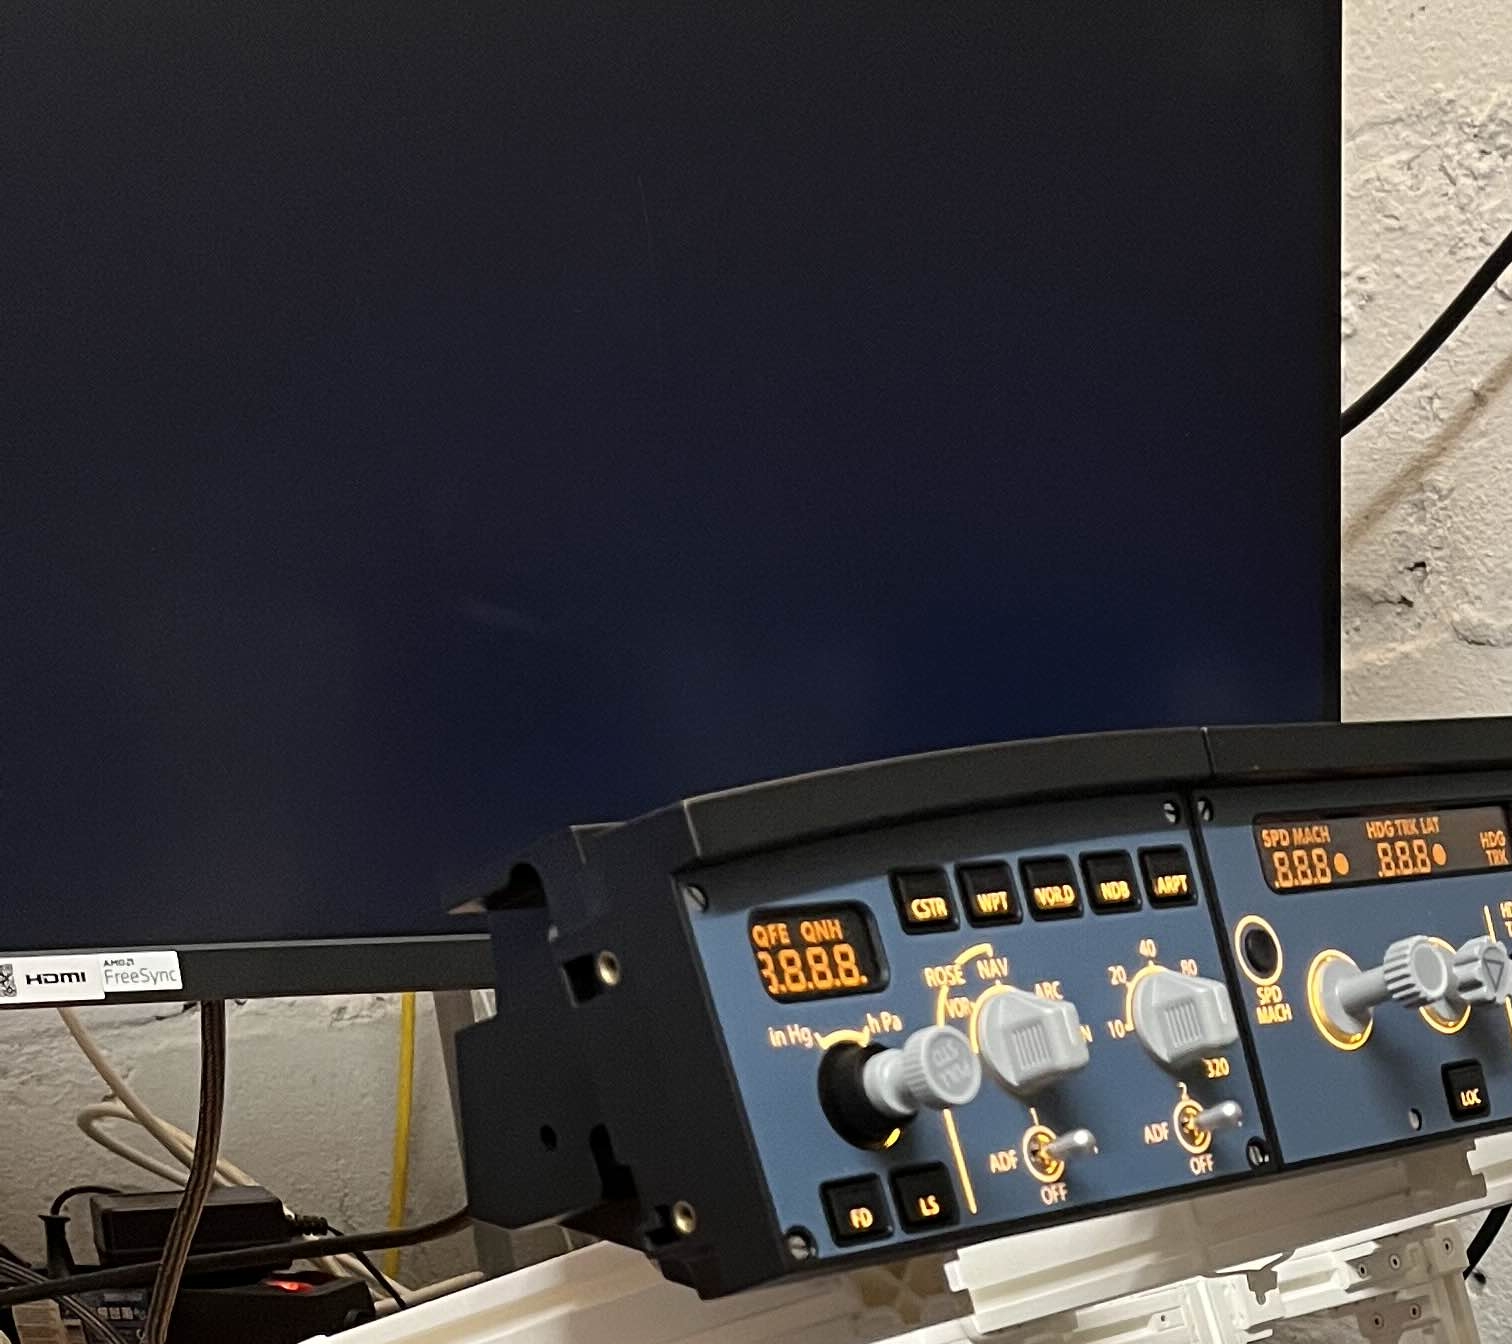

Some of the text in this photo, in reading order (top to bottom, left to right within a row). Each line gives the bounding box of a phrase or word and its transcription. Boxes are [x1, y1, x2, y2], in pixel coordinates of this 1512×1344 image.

[1262, 826, 1330, 848] SPD MACH
[1366, 820, 1394, 839] HDG
[1395, 819, 1418, 837] TRK
[1480, 832, 1505, 848] HDG
[1486, 849, 1508, 866] TRK
[1101, 880, 1129, 900] NDB
[912, 898, 947, 920] CSTR
[978, 891, 1008, 912] WPT
[753, 919, 843, 945] QFE QNH
[1139, 939, 1156, 959] 40
[26, 972, 86, 985] HDMI
[105, 968, 178, 985] FreeSync
[925, 965, 965, 987] ROSE
[978, 958, 1009, 979] NAV
[1107, 966, 1128, 987] 20
[1257, 986, 1282, 1006] SPD
[1256, 1006, 1292, 1025] MACH
[1107, 1020, 1126, 1039] 10
[1204, 1057, 1230, 1079] 320
[1461, 1088, 1482, 1105] LOC
[1144, 1122, 1169, 1145] ADF
[989, 1150, 1019, 1173] ADF
[1189, 1154, 1215, 1175] OFF
[1040, 1183, 1068, 1205] OFF
[919, 1196, 940, 1218] LS
[850, 1208, 873, 1228] FD
